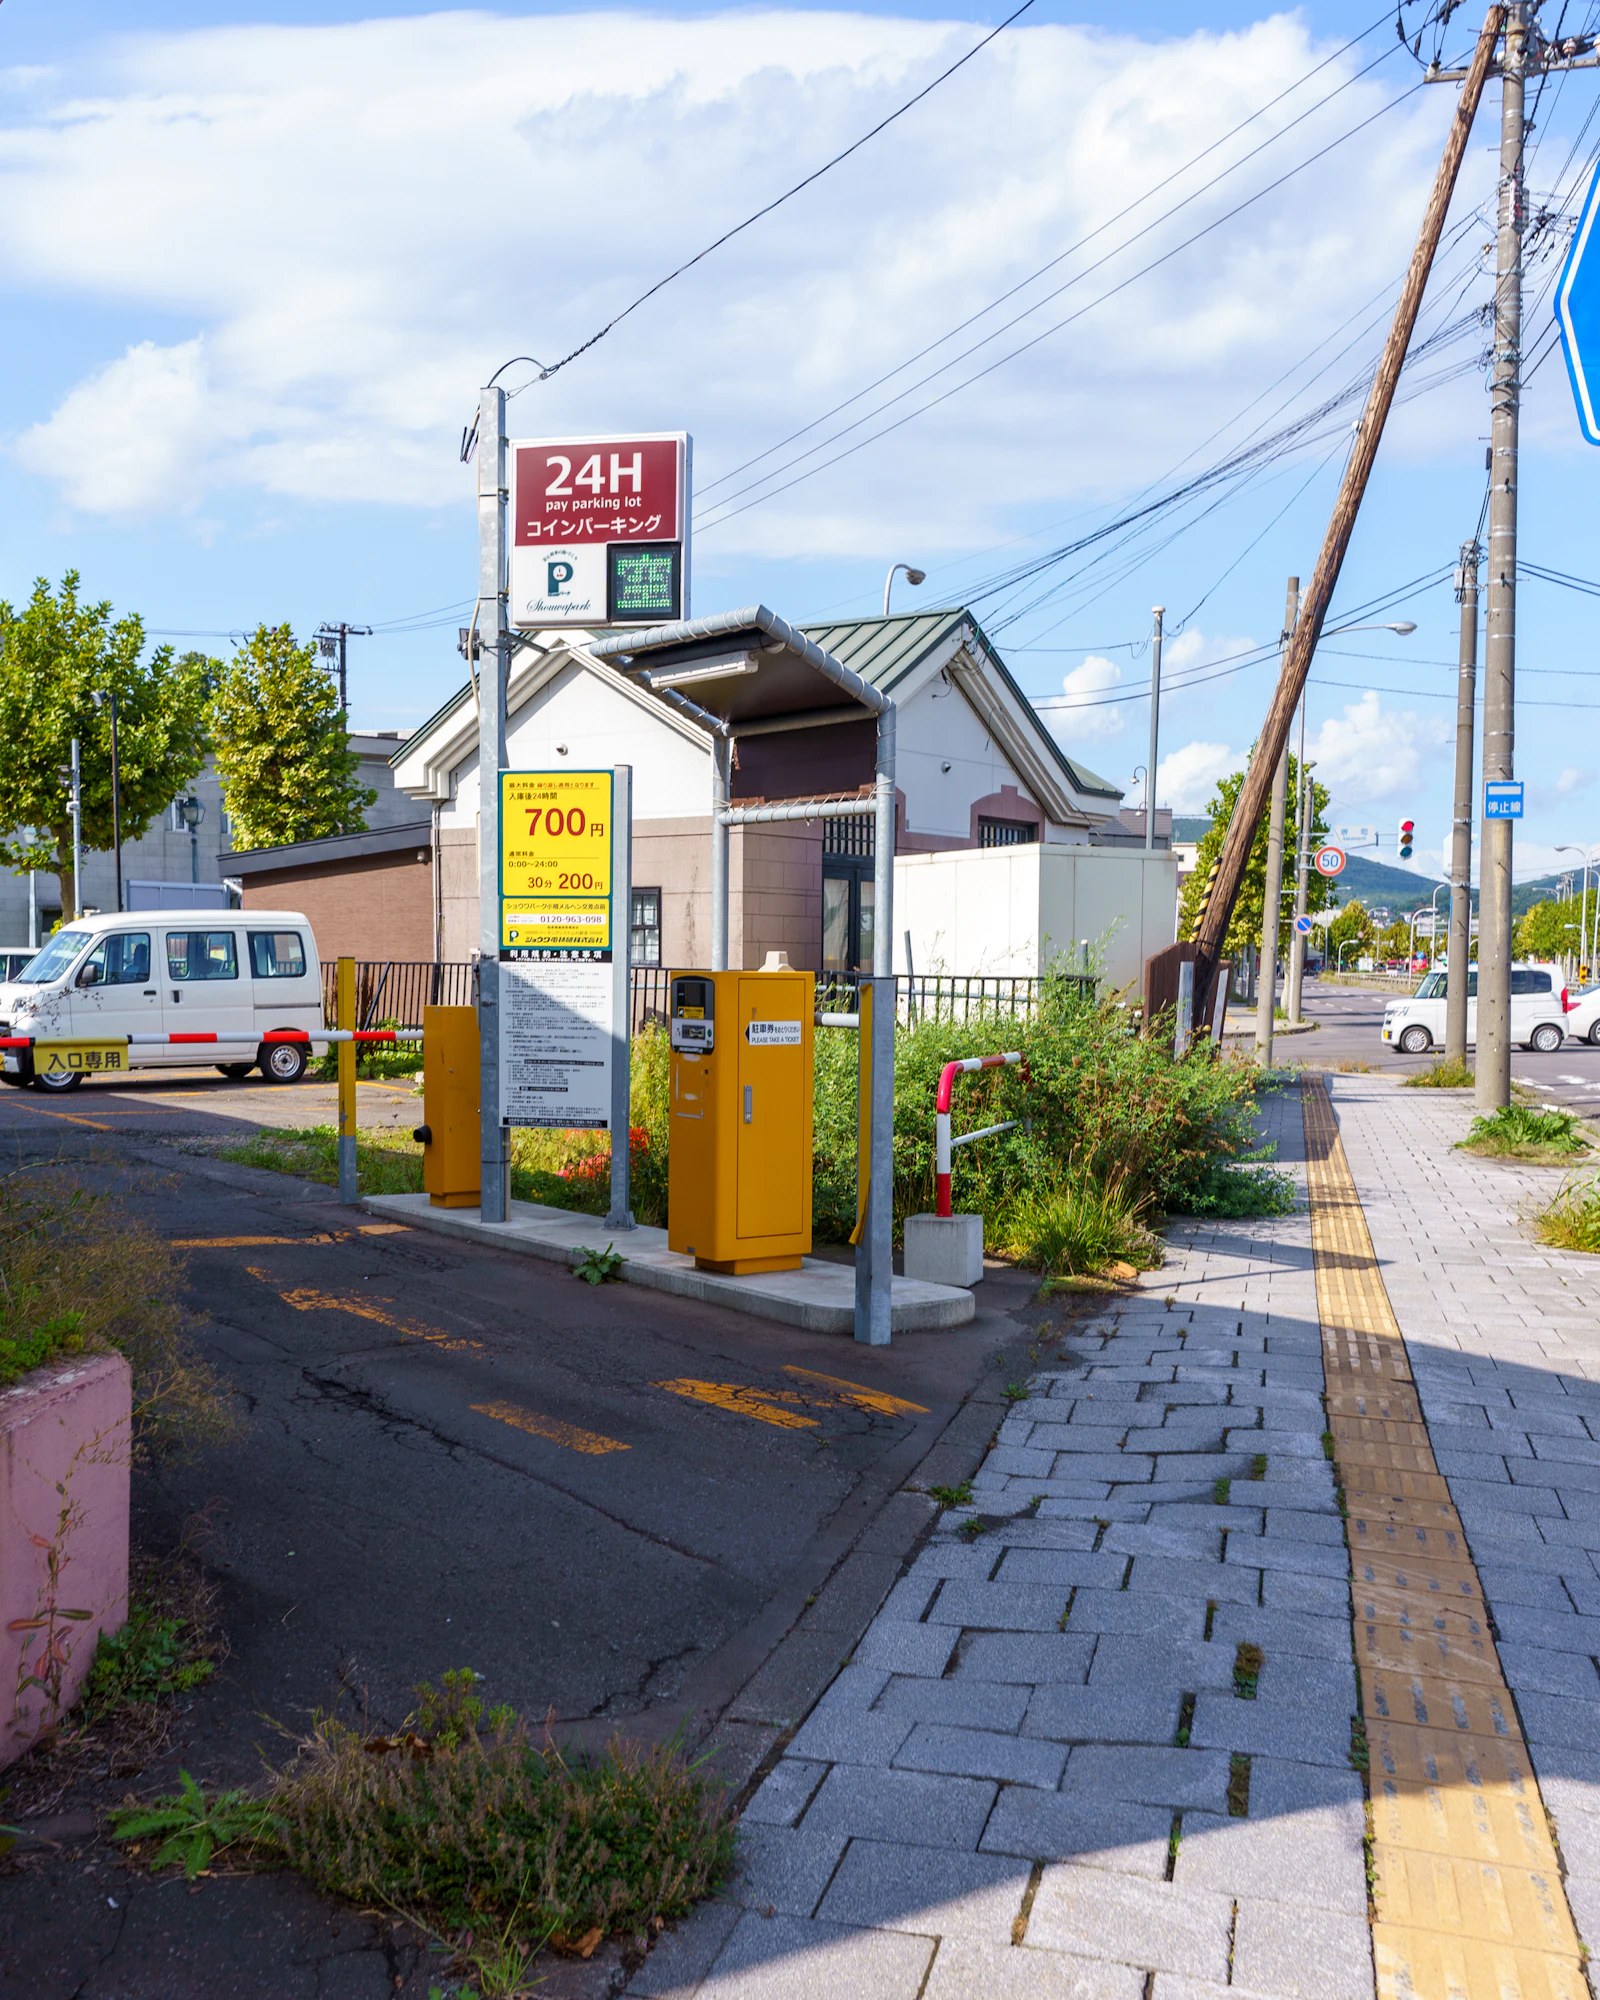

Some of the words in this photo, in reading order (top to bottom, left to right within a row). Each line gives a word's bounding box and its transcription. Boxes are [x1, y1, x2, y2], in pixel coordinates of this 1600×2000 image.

[545, 452, 642, 497] 24H
[545, 499, 568, 513] pay
[572, 498, 620, 512] parking
[624, 496, 642, 508] lot
[526, 514, 662, 537] コインパーキング
[508, 792, 558, 801] 入庫後24時間
[1488, 801, 1521, 813] 停止線
[1322, 854, 1339, 867] 50
[540, 915, 602, 923] 0120-963-098
[47, 1051, 122, 1071] 入口専用
